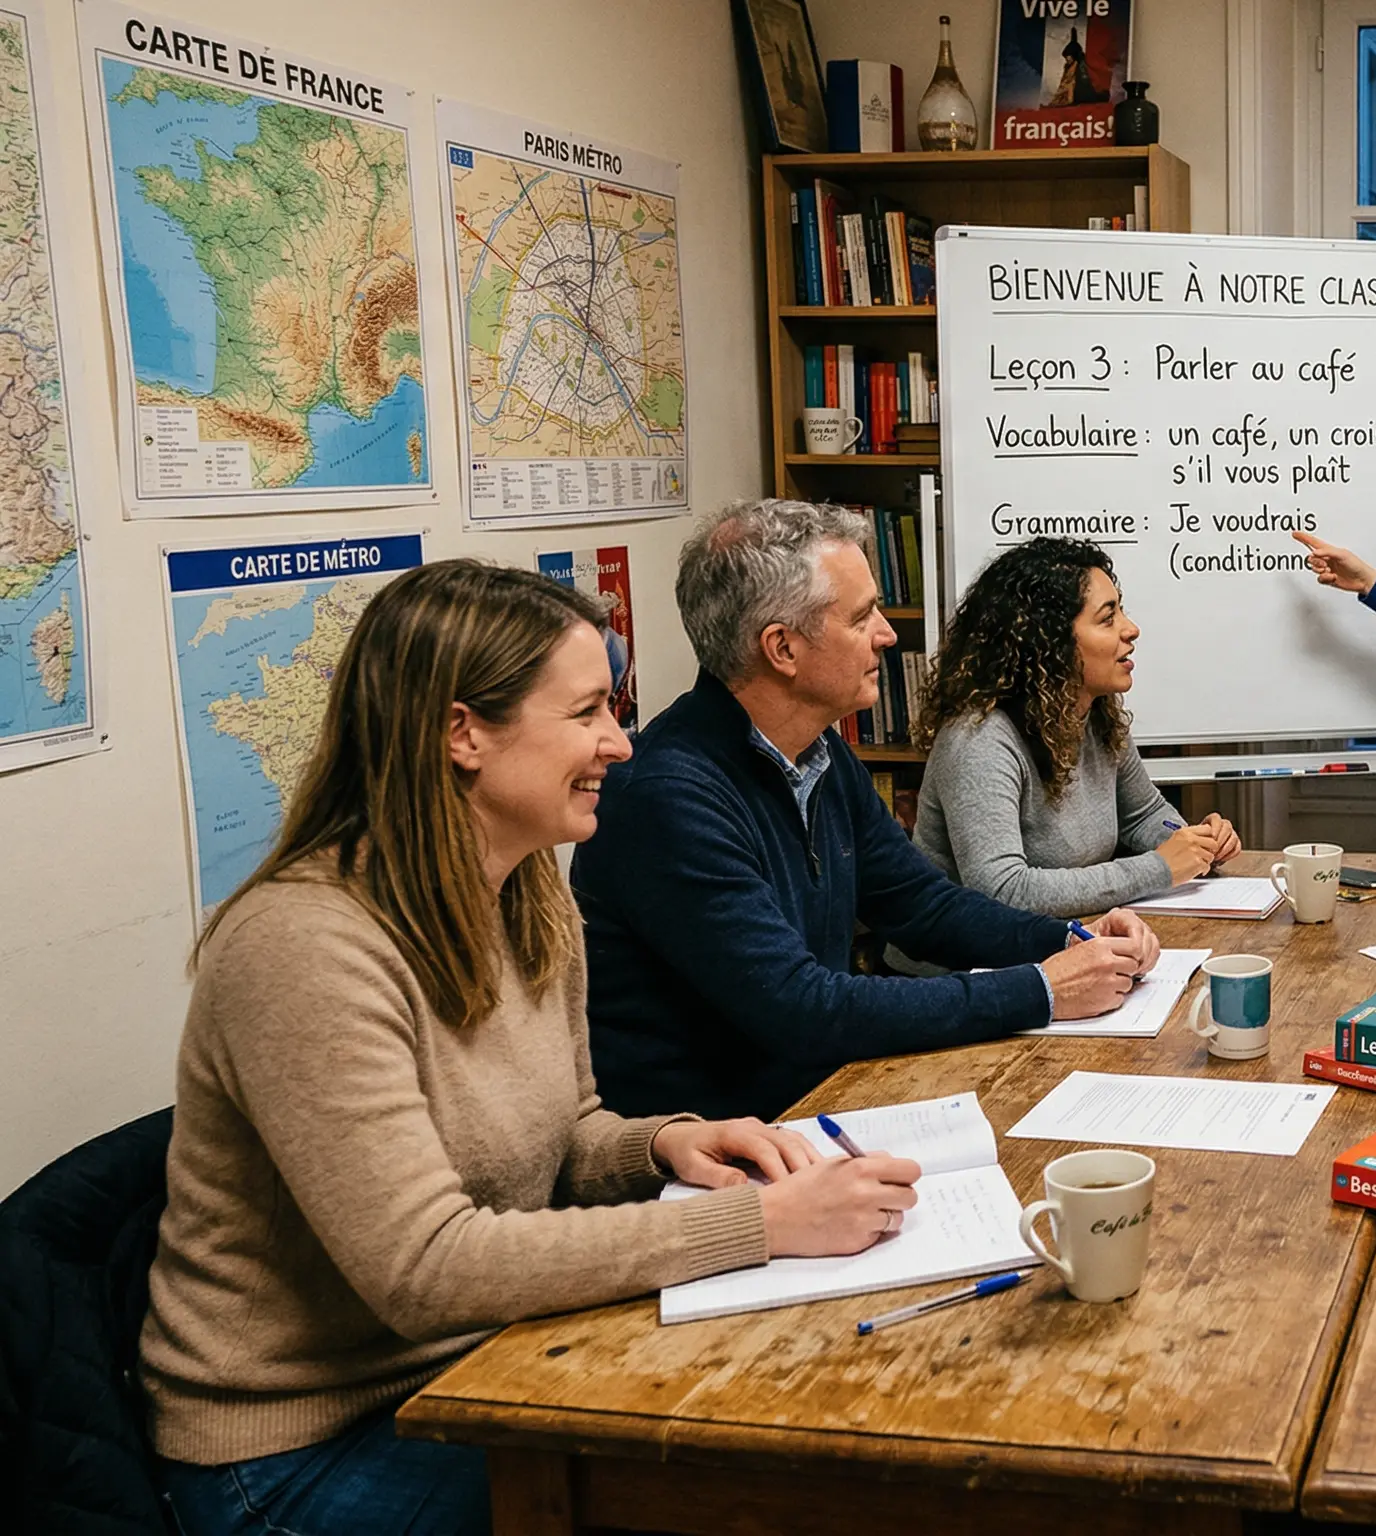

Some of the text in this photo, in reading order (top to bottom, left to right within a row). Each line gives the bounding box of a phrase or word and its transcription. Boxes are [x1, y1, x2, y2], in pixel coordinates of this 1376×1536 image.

[1021, 0, 1109, 18] Vive le
[125, 19, 385, 114] CARTE DE FRANCE
[1003, 115, 1115, 147] français!
[524, 131, 623, 175] PARIS MÉTRO
[989, 259, 1164, 302] BIENVENUE
[1184, 261, 1204, 303] À
[1220, 274, 1305, 305] NOTRE
[990, 344, 1076, 391] Leçon
[1091, 345, 1111, 381] 3
[1155, 343, 1238, 380] Parler
[1252, 362, 1284, 381] au
[1298, 348, 1356, 394] café
[1168, 427, 1199, 446] un
[1212, 413, 1277, 457] café,
[1289, 428, 1319, 446] un
[1173, 453, 1351, 495] s'il vous plaît
[1169, 503, 1201, 533] Je
[1212, 503, 1317, 532] voudrais
[230, 541, 381, 579] CARTE DE MÉTRO
